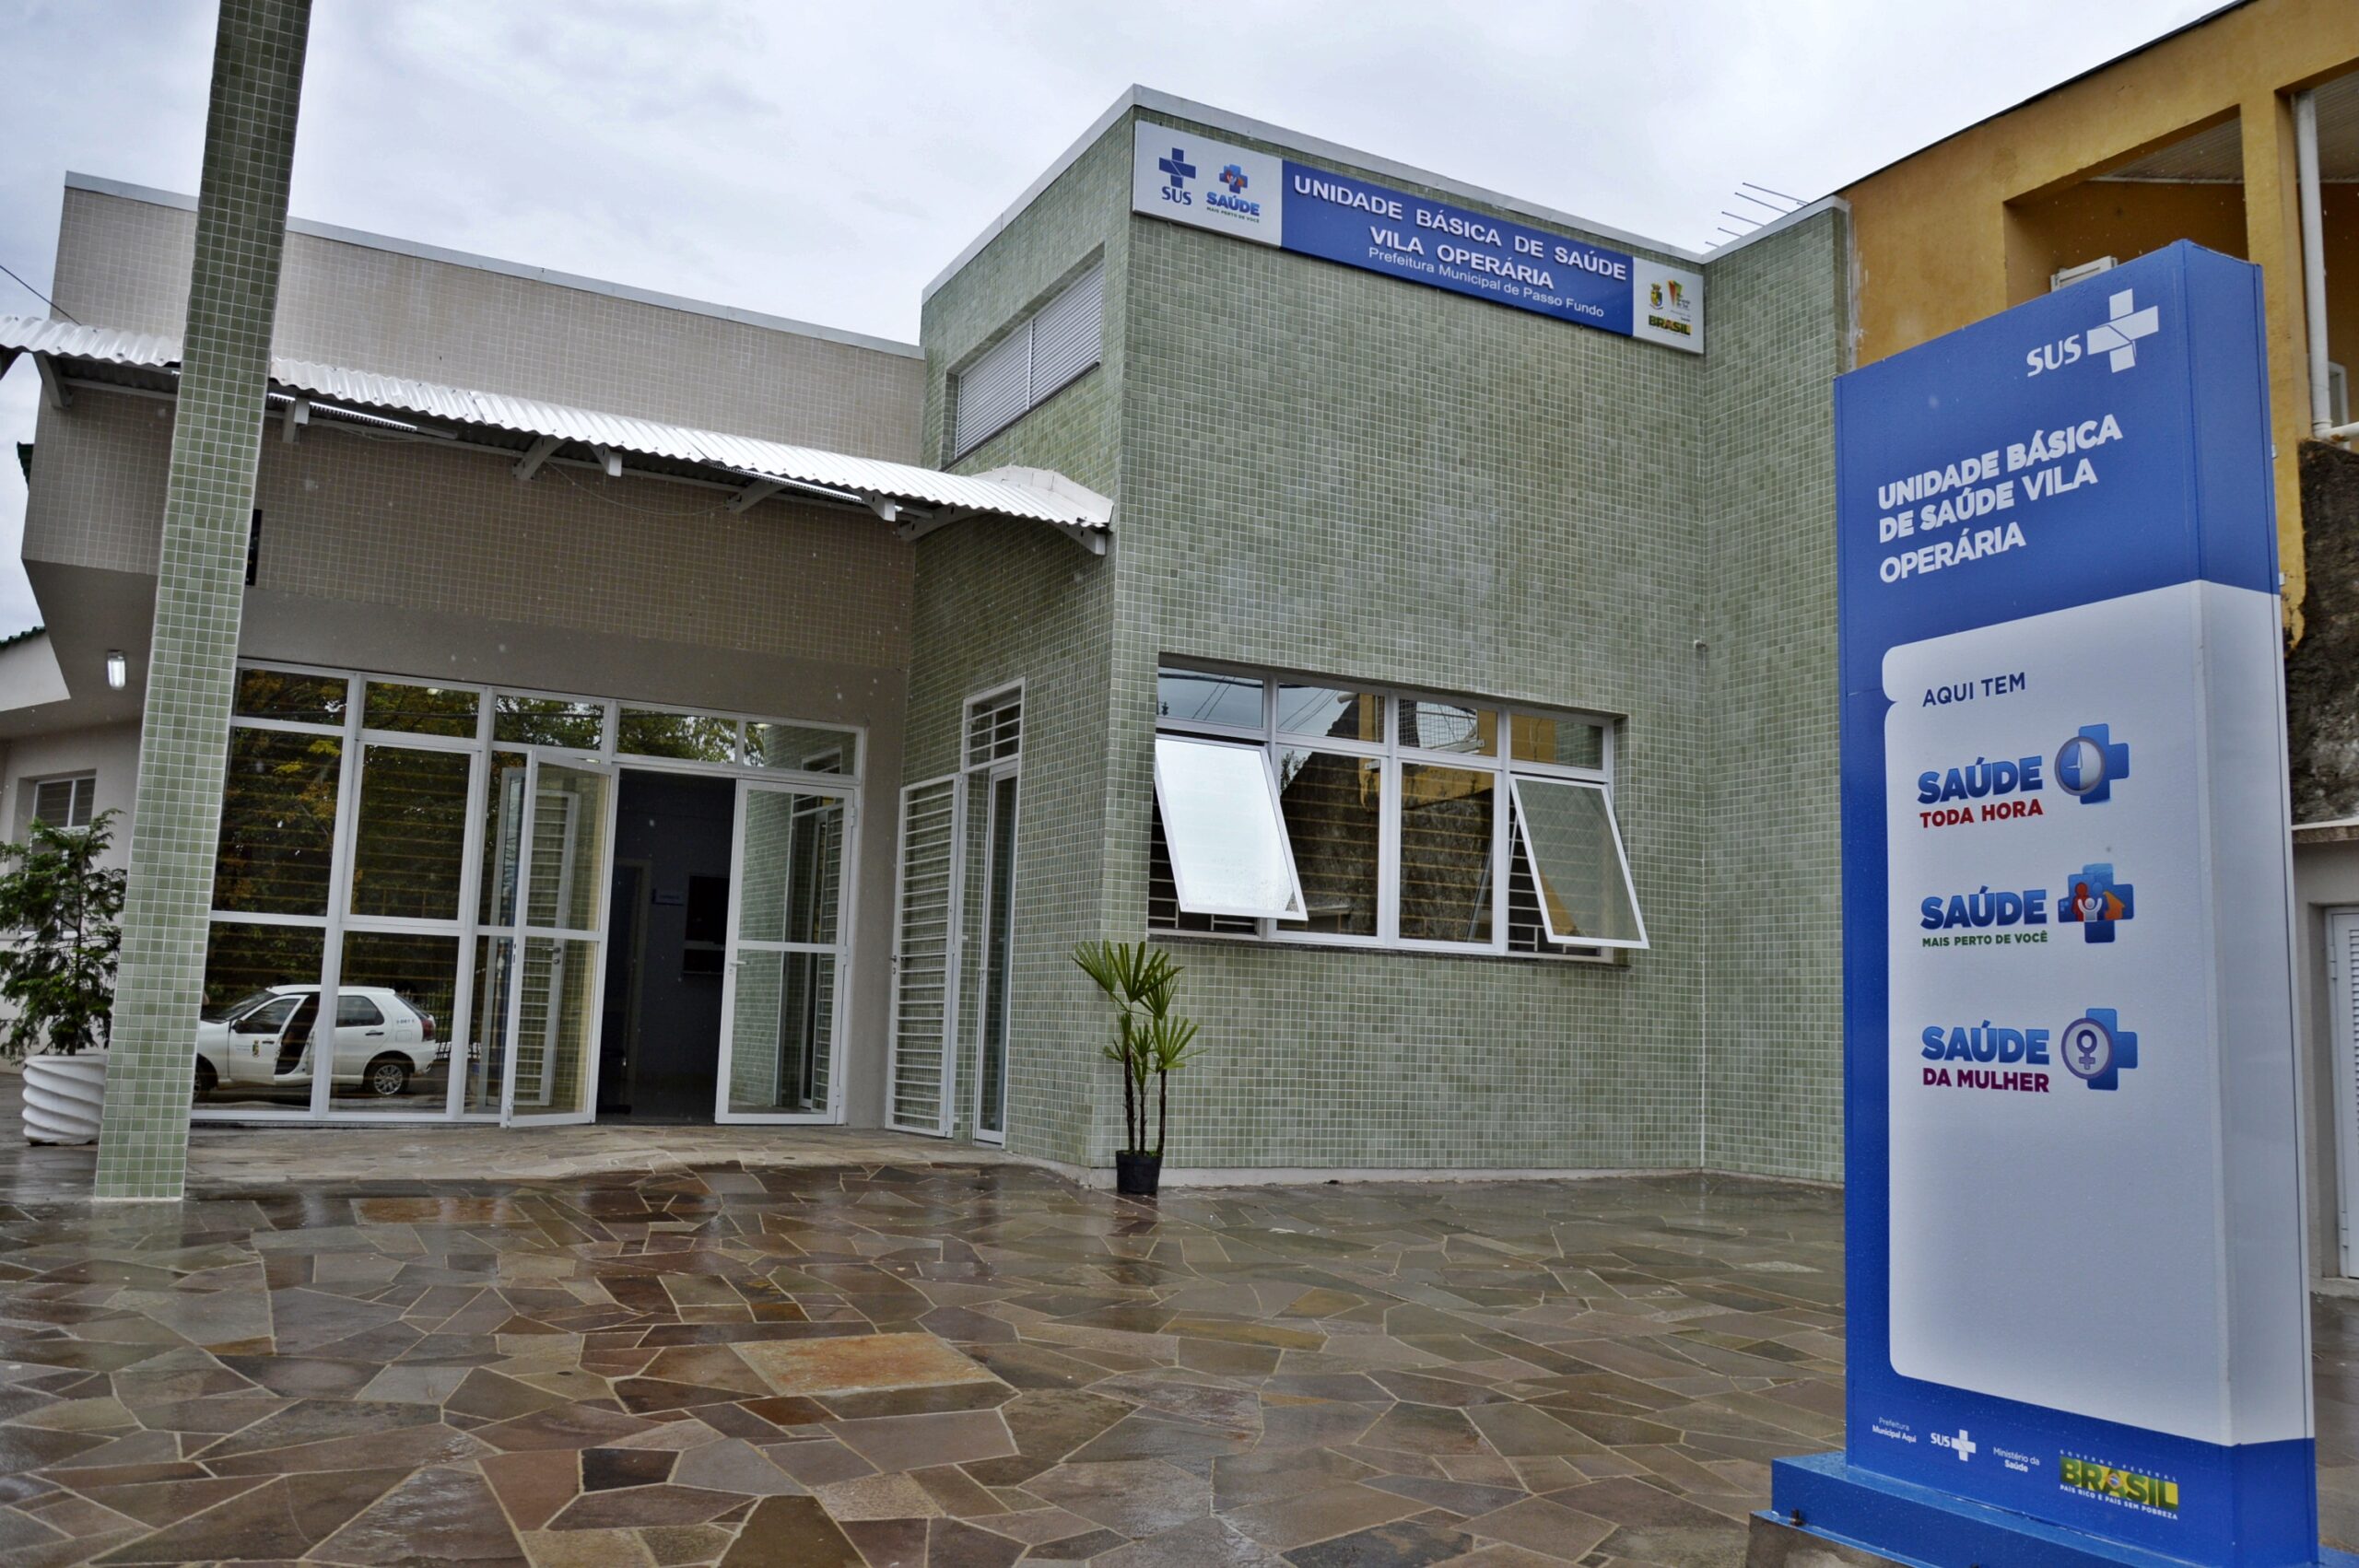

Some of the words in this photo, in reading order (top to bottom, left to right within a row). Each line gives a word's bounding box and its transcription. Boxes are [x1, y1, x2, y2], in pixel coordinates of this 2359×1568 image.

[1162, 186, 1191, 205] SUS
[1206, 192, 1260, 216] SAÚDE
[1294, 175, 1402, 220] UNIDADE
[1416, 208, 1502, 247] BÁSICA
[1515, 235, 1543, 259] DE
[1554, 246, 1626, 281] SAÚDE
[1369, 227, 1424, 256] VILA
[1437, 244, 1554, 289] OPERÁRIA
[1369, 247, 1435, 273] Prefeitura
[1439, 264, 1501, 291] Municipal
[1503, 280, 1520, 296] de
[1524, 287, 1562, 307] Passo
[1567, 298, 1604, 318] Fundo
[1649, 315, 1691, 336] BRASIL
[2026, 334, 2082, 377] SUS
[1878, 451, 1999, 509] UNIDADE
[2007, 414, 2123, 472] BÁSICA
[1879, 510, 1914, 543] DE
[1920, 481, 2014, 532] SAÚDE
[2022, 458, 2098, 501] VILA
[1879, 521, 2026, 583] OPERÁRIA
[1922, 682, 1973, 707] AQUI
[1981, 672, 2026, 697] TEM
[1917, 755, 2043, 804] SAÚDE
[1919, 806, 1974, 828] TODA
[1982, 798, 2043, 822] HORA
[1920, 885, 2047, 930] SAÚDE
[1922, 936, 1950, 948] MAIS
[1954, 934, 1992, 947] PERTO
[1995, 933, 2012, 944] DE
[2014, 930, 2048, 943] VOCÊ
[1921, 1020, 2050, 1065] SAÚDE
[1923, 1068, 1951, 1087] DA
[1957, 1070, 2049, 1093] MULHER
[1872, 1425, 1901, 1439] Municipal
[1902, 1432, 1917, 1443] Aqui
[1878, 1417, 1910, 1431] Prefeitura
[1931, 1433, 1950, 1447] SUS
[1993, 1446, 2028, 1463] Ministério
[2030, 1456, 2040, 1466] da
[2005, 1459, 2029, 1473] Saúde
[2060, 1456, 2178, 1511] BRASIL
[2123, 1464, 2177, 1482] FEDERAL
[2078, 1489, 2095, 1499] RICO
[2124, 1501, 2138, 1510] SEM
[2141, 1505, 2178, 1520] POBREZA
